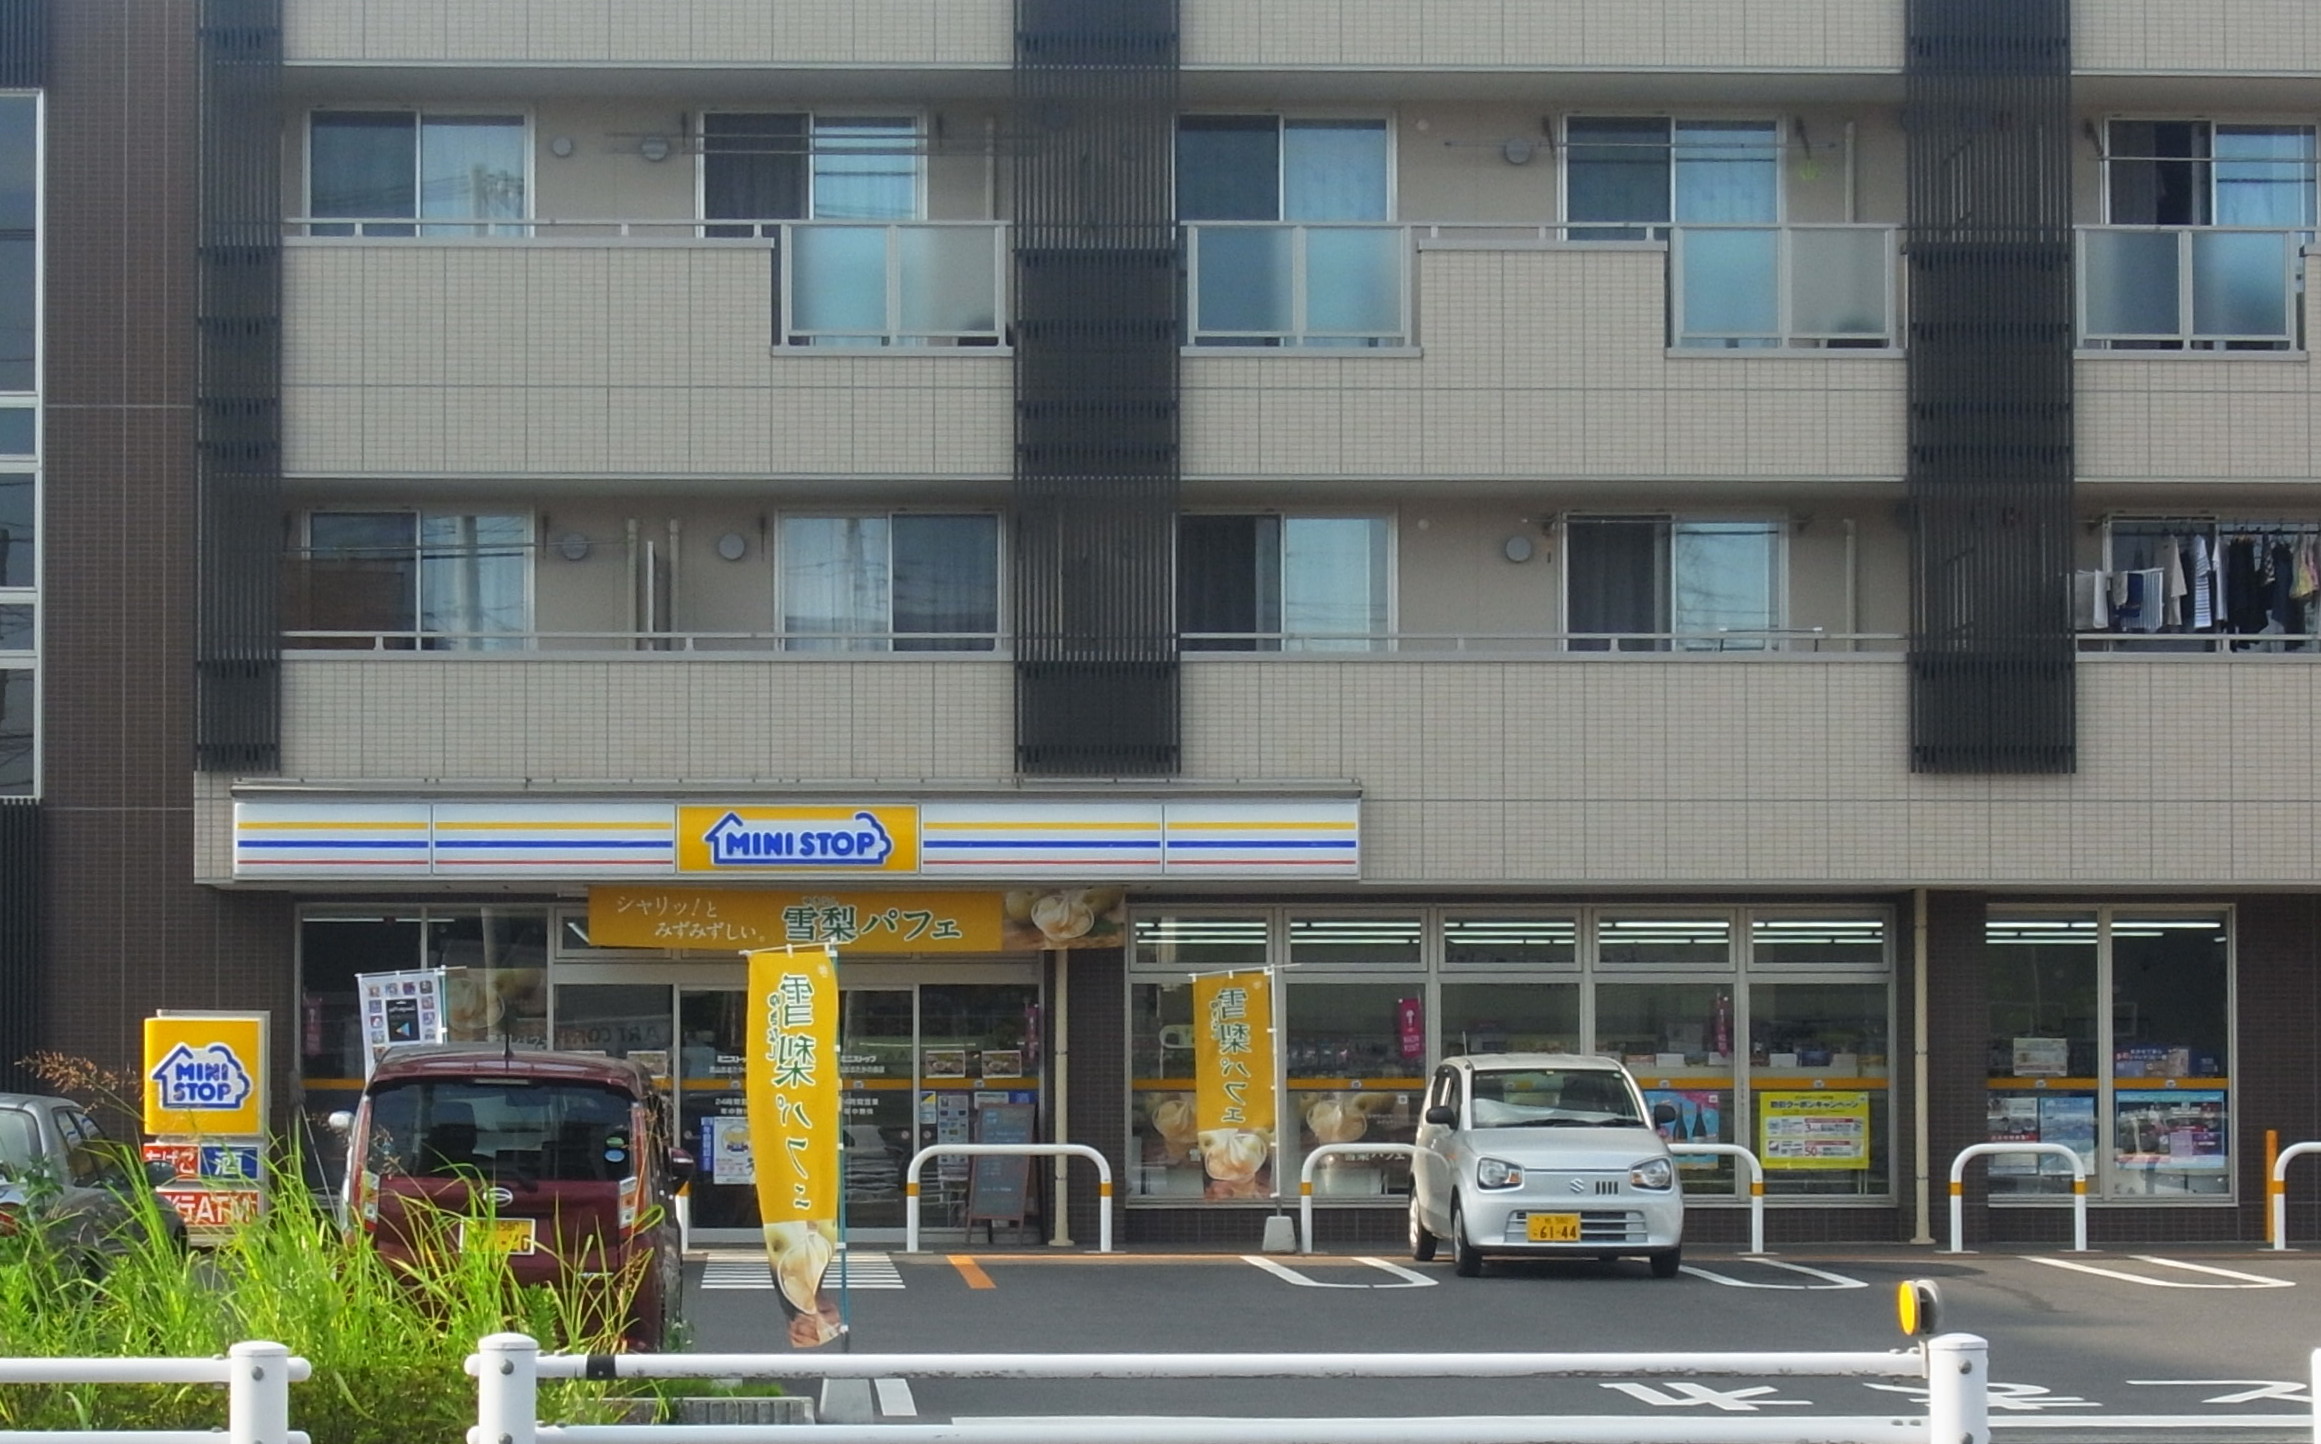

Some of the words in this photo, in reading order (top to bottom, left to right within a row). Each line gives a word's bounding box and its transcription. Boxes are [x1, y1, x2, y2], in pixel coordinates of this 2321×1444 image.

[725, 831, 794, 857] MINI
[800, 831, 875, 857] STOP
[654, 921, 766, 942] みずみずしい。
[781, 904, 963, 943] 雪梨パフェ
[716, 1055, 747, 1064] ミニストッ
[176, 1063, 229, 1082] MINI
[173, 1082, 232, 1102] STOP
[714, 1097, 747, 1106] 24時間営
[844, 1097, 879, 1106] 4時間営業
[214, 1151, 244, 1176] 酒
[1540, 1226, 1577, 1240] 61-44
